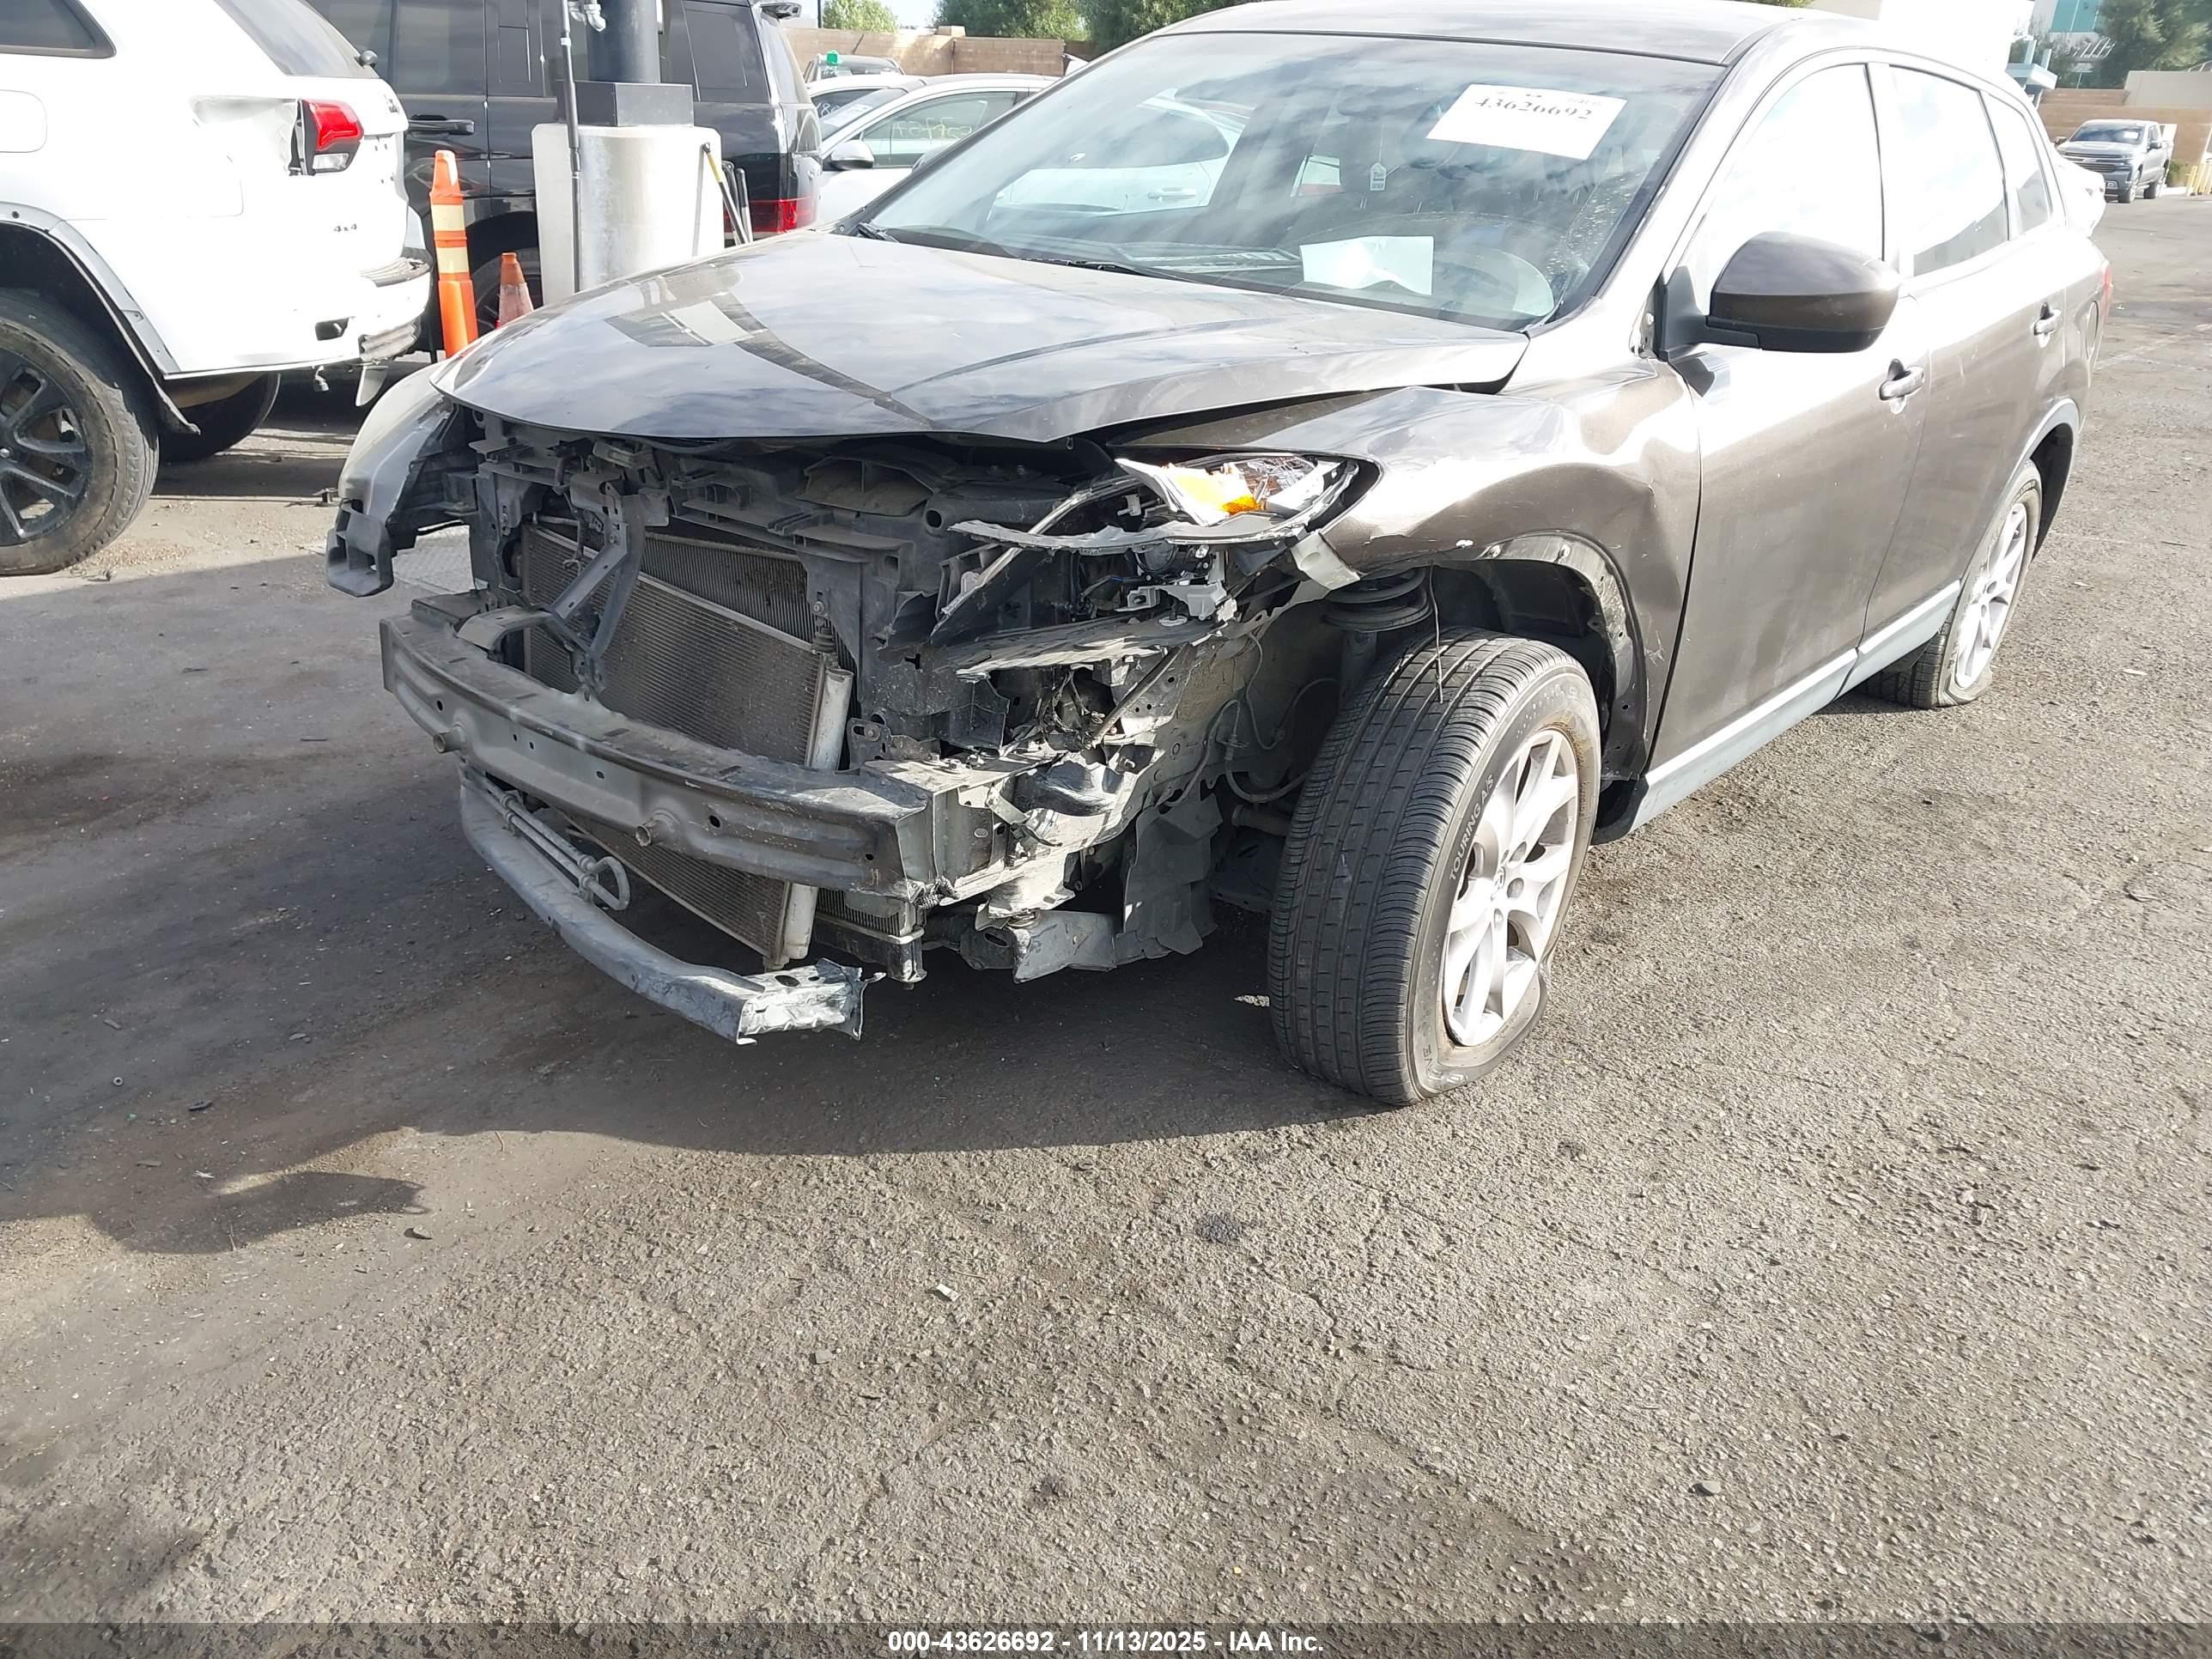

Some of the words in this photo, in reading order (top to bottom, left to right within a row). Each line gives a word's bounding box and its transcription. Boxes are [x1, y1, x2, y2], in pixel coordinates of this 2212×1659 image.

[1474, 96, 1593, 119] 43626692
[1449, 802, 1481, 880] TOURING
[1480, 774, 1493, 805] A/S
